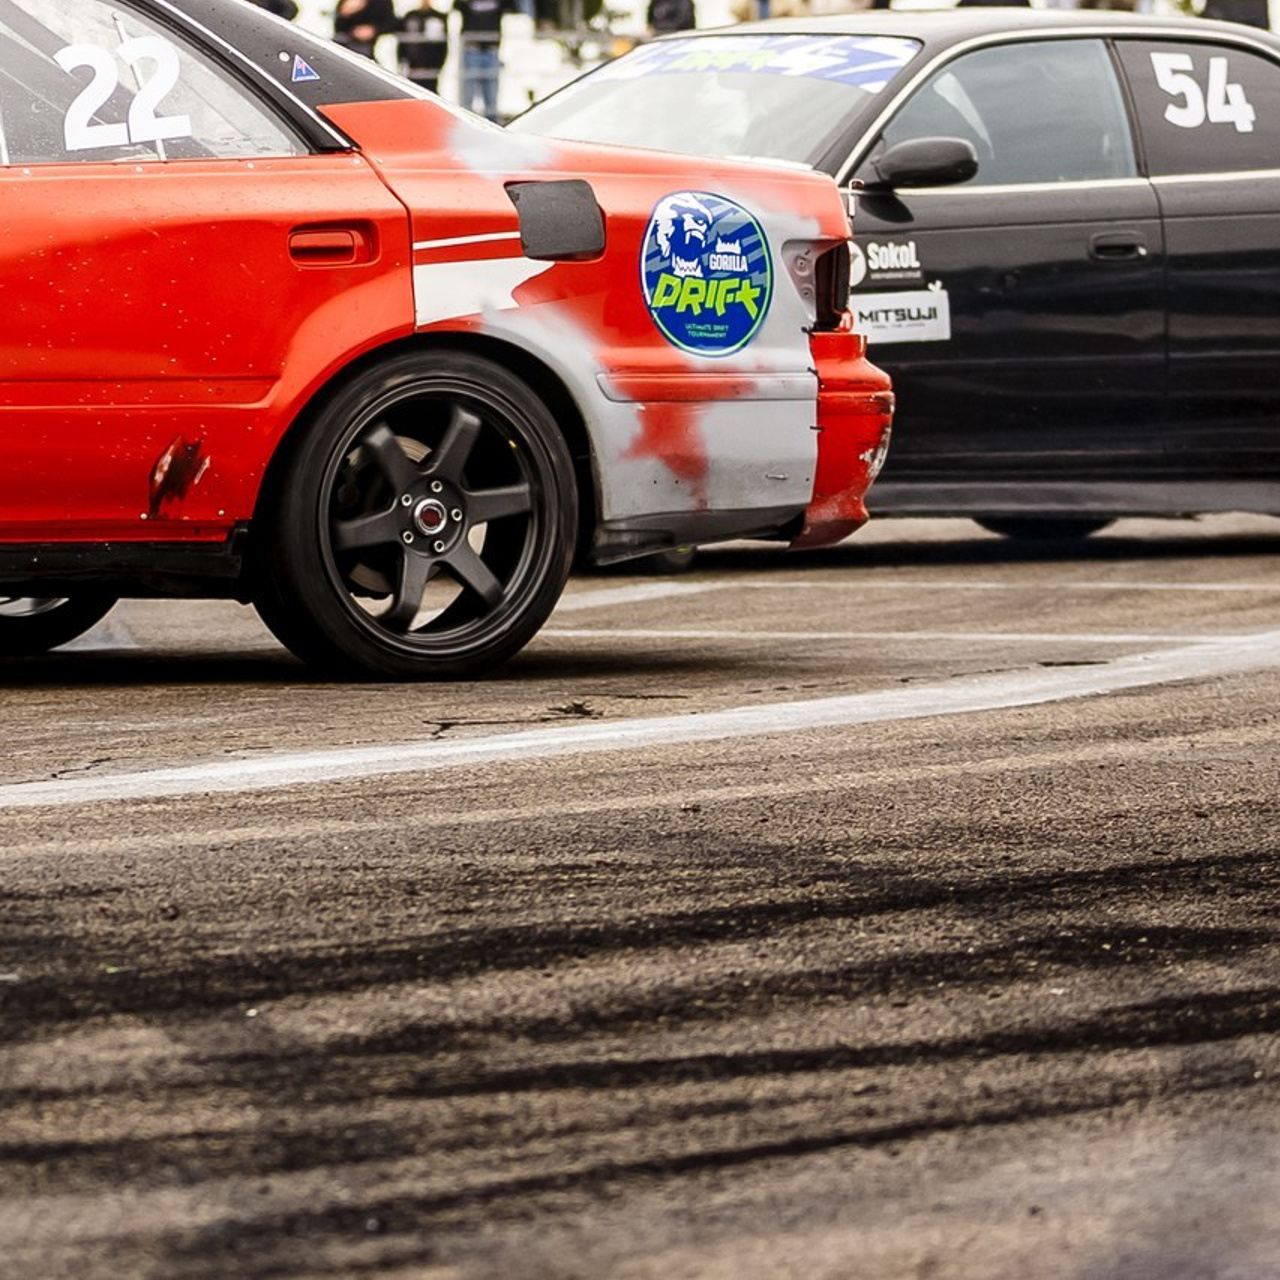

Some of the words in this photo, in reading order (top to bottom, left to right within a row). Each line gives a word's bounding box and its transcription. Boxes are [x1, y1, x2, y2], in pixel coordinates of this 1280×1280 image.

[52, 36, 192, 151] 22
[1150, 52, 1257, 133] 54
[709, 254, 749, 272] GORILLA
[858, 306, 938, 324] MITSUJI
